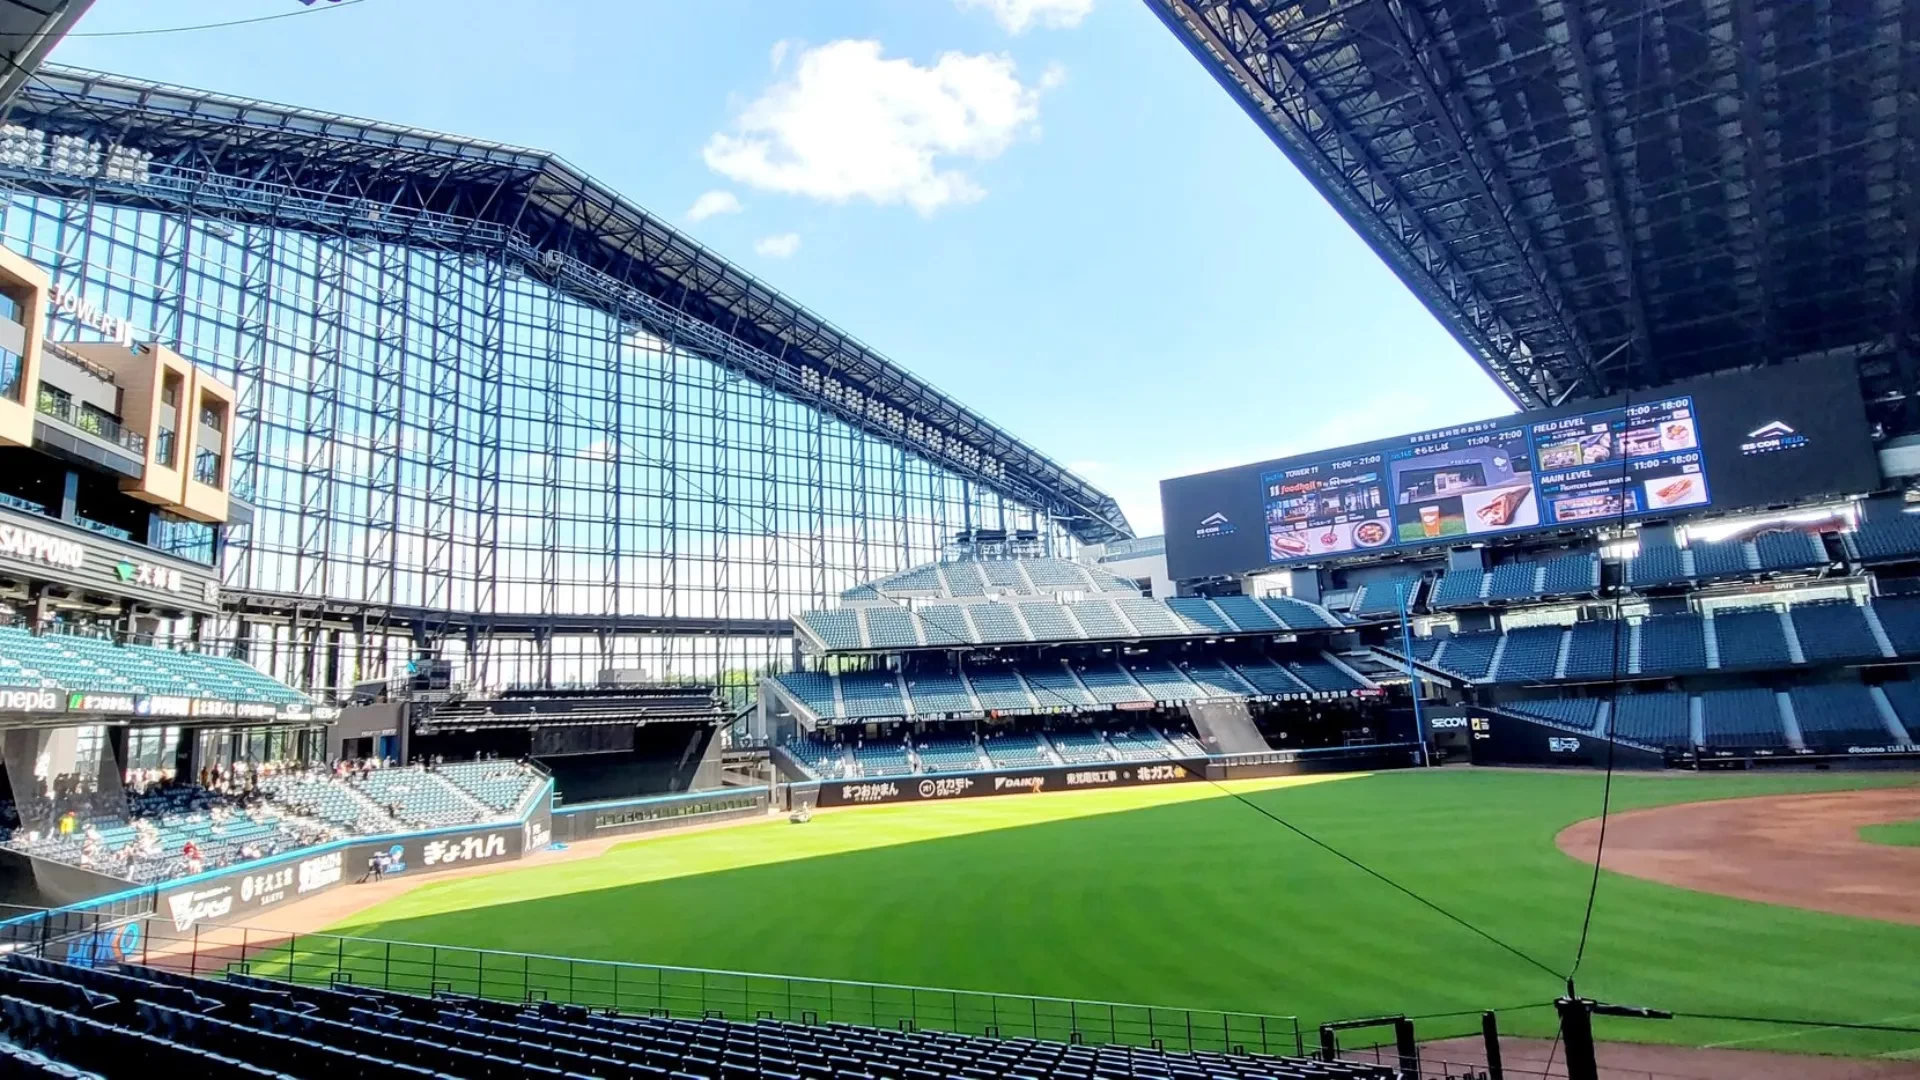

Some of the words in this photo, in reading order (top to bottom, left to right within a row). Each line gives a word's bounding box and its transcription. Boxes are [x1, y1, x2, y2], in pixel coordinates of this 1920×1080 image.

[53, 281, 113, 336] TOWER
[1660, 399, 1688, 410] 18:00
[1533, 422, 1558, 434] FIELD
[1559, 417, 1585, 429] LEVEL
[1467, 435, 1490, 446] 11:00
[1498, 429, 1522, 440] 21:00
[1331, 460, 1352, 470] 11:00
[1359, 455, 1381, 466] 21:00
[1634, 459, 1660, 470] 11:00
[1669, 453, 1699, 464] 18:00
[1285, 467, 1310, 478] TOWER
[1311, 466, 1319, 475] 11
[1541, 473, 1565, 485] MAIN
[1566, 470, 1593, 481] LEVEL
[0, 523, 83, 569] SAPPORO
[0, 687, 56, 712] nepia
[1431, 716, 1468, 728] SECOM
[1847, 746, 1885, 754] docomo
[1137, 765, 1175, 781] 北ガス
[936, 777, 974, 789] オカモト
[423, 833, 506, 866] ぎょれん
